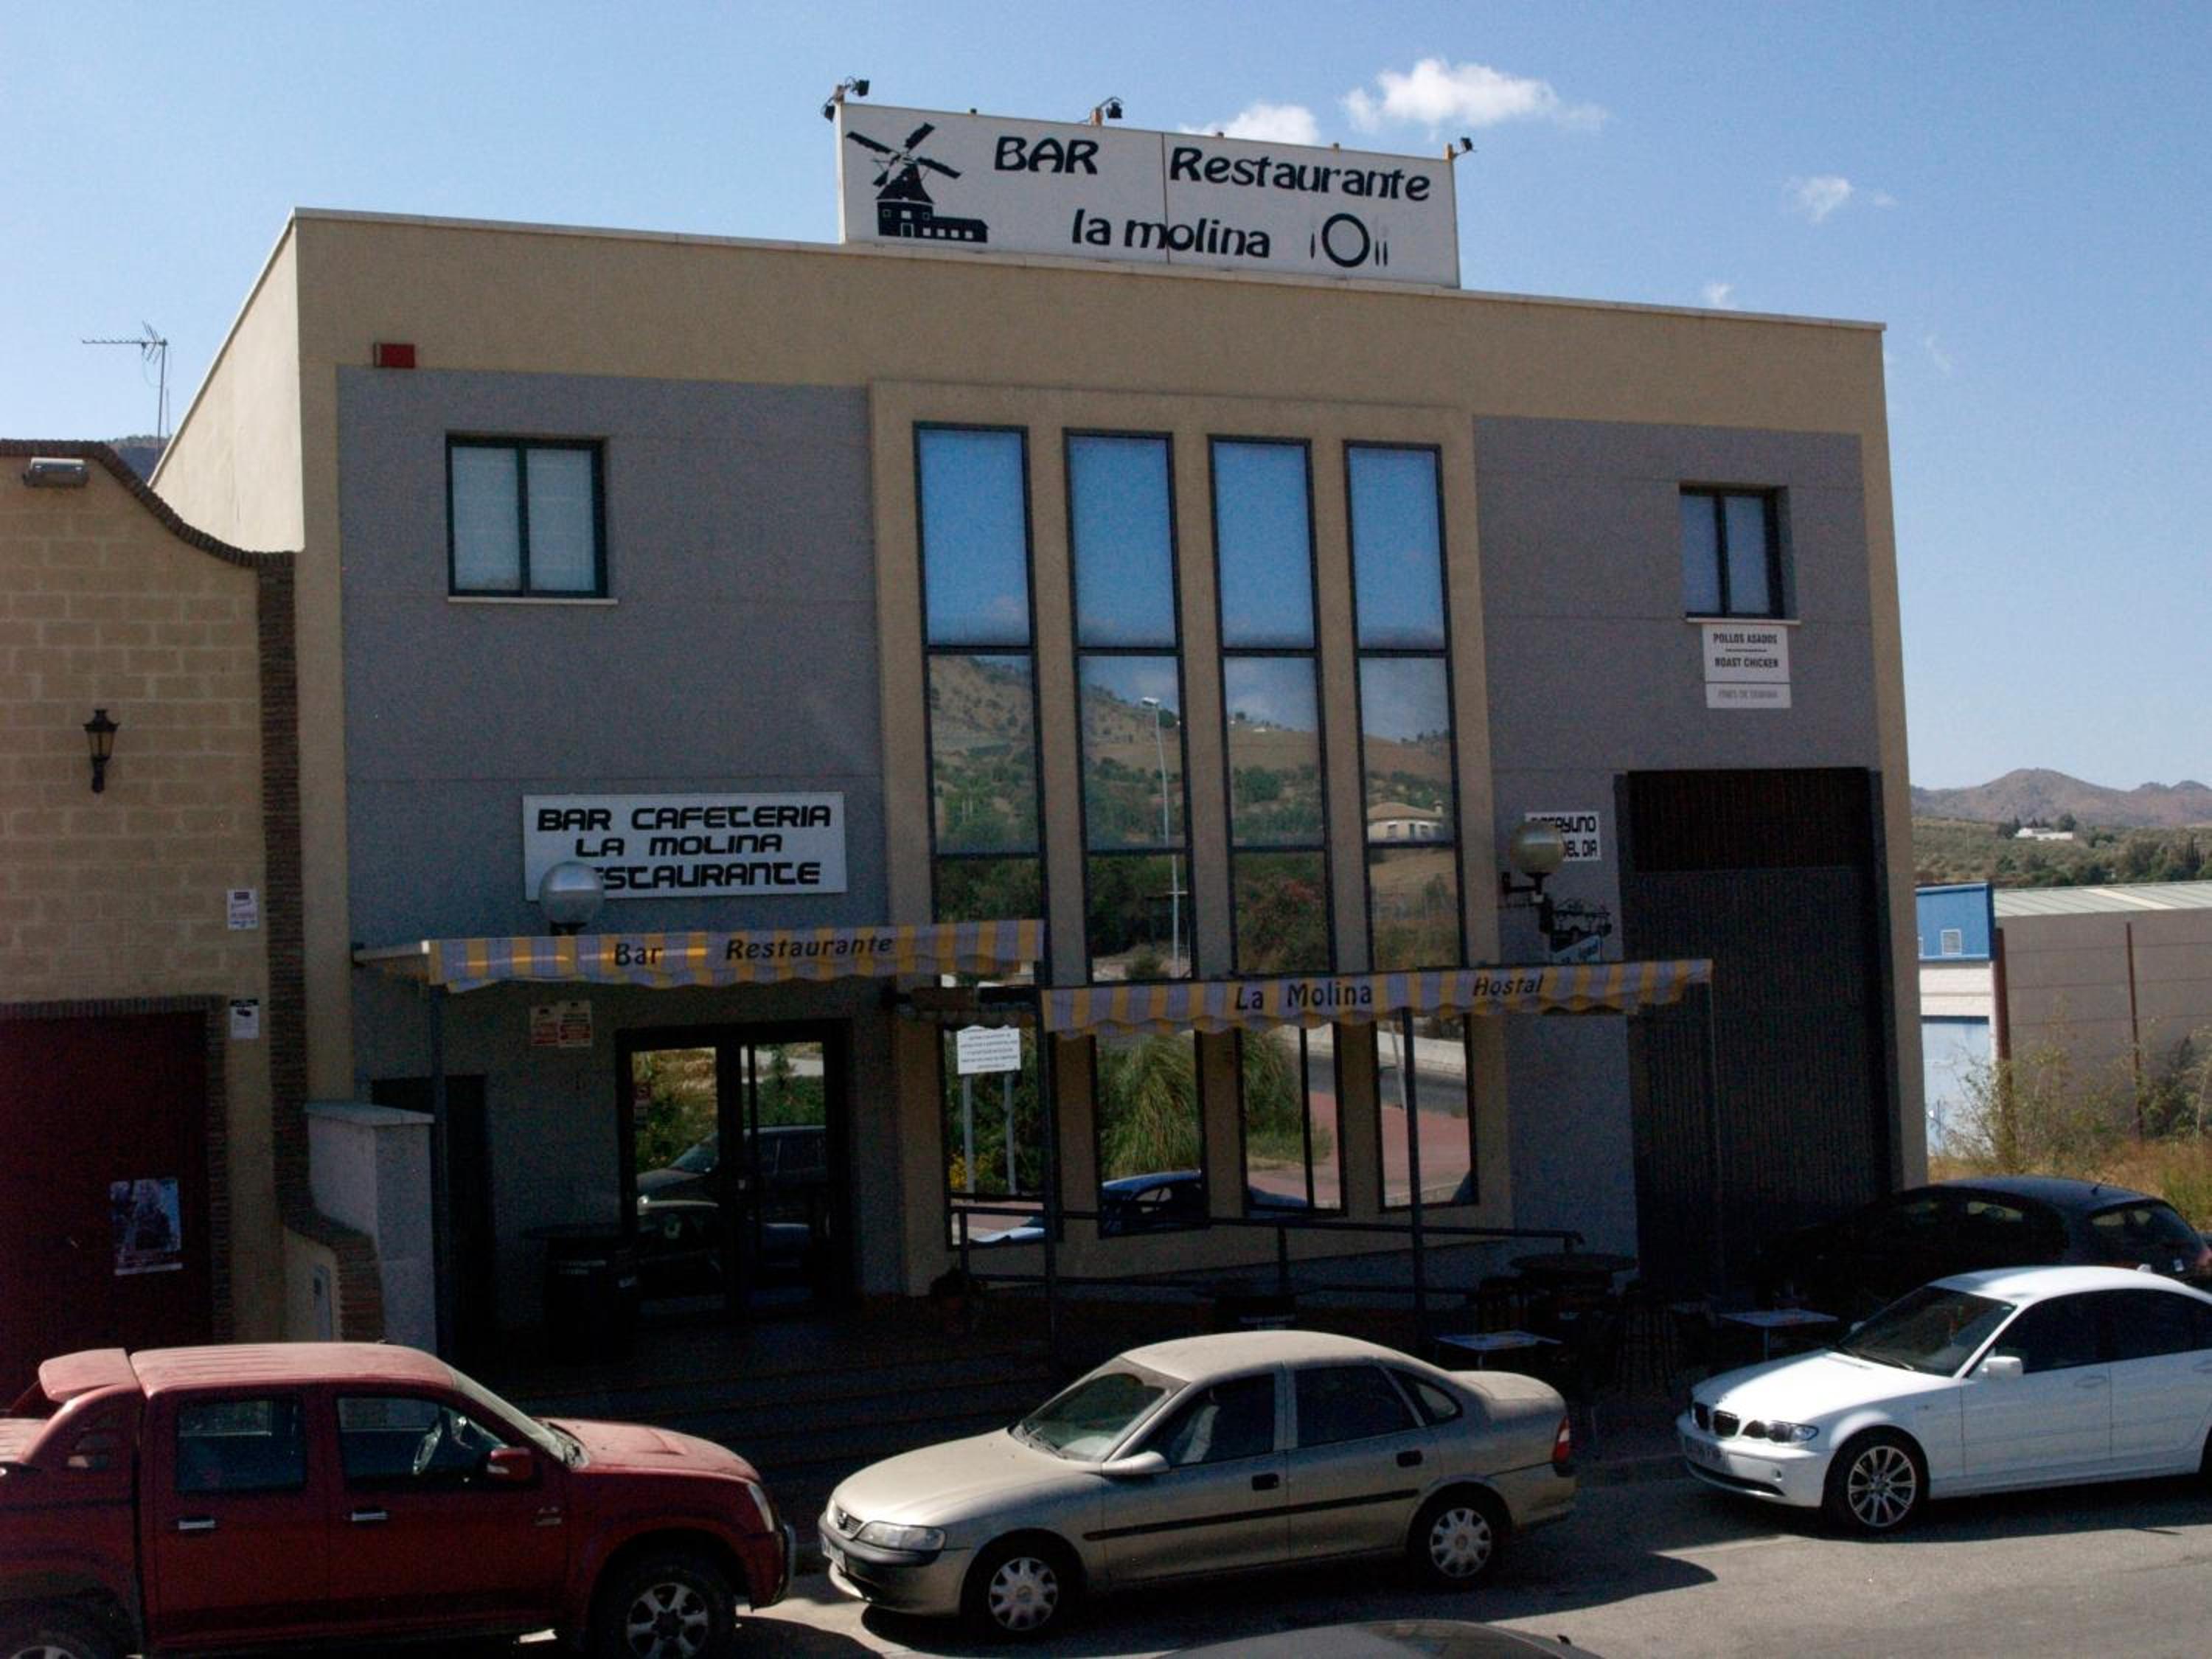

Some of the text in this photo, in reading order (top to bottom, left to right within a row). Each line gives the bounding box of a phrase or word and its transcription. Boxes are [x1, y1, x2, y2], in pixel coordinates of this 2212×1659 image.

[995, 136, 1430, 202] BAR Restaurante
[1072, 209, 1270, 259] la molina
[1713, 633, 1778, 644] POLLOS ASADOS
[1714, 656, 1778, 669] ROAST CHICKEN
[537, 805, 831, 832] BAR CAFETERIA
[575, 833, 782, 858] LA MOLINA
[592, 862, 821, 890] STAURANTE
[615, 937, 894, 966] Bar Restaurante
[1235, 982, 1372, 1010] La Molina
[1472, 973, 1545, 996] Hostal
